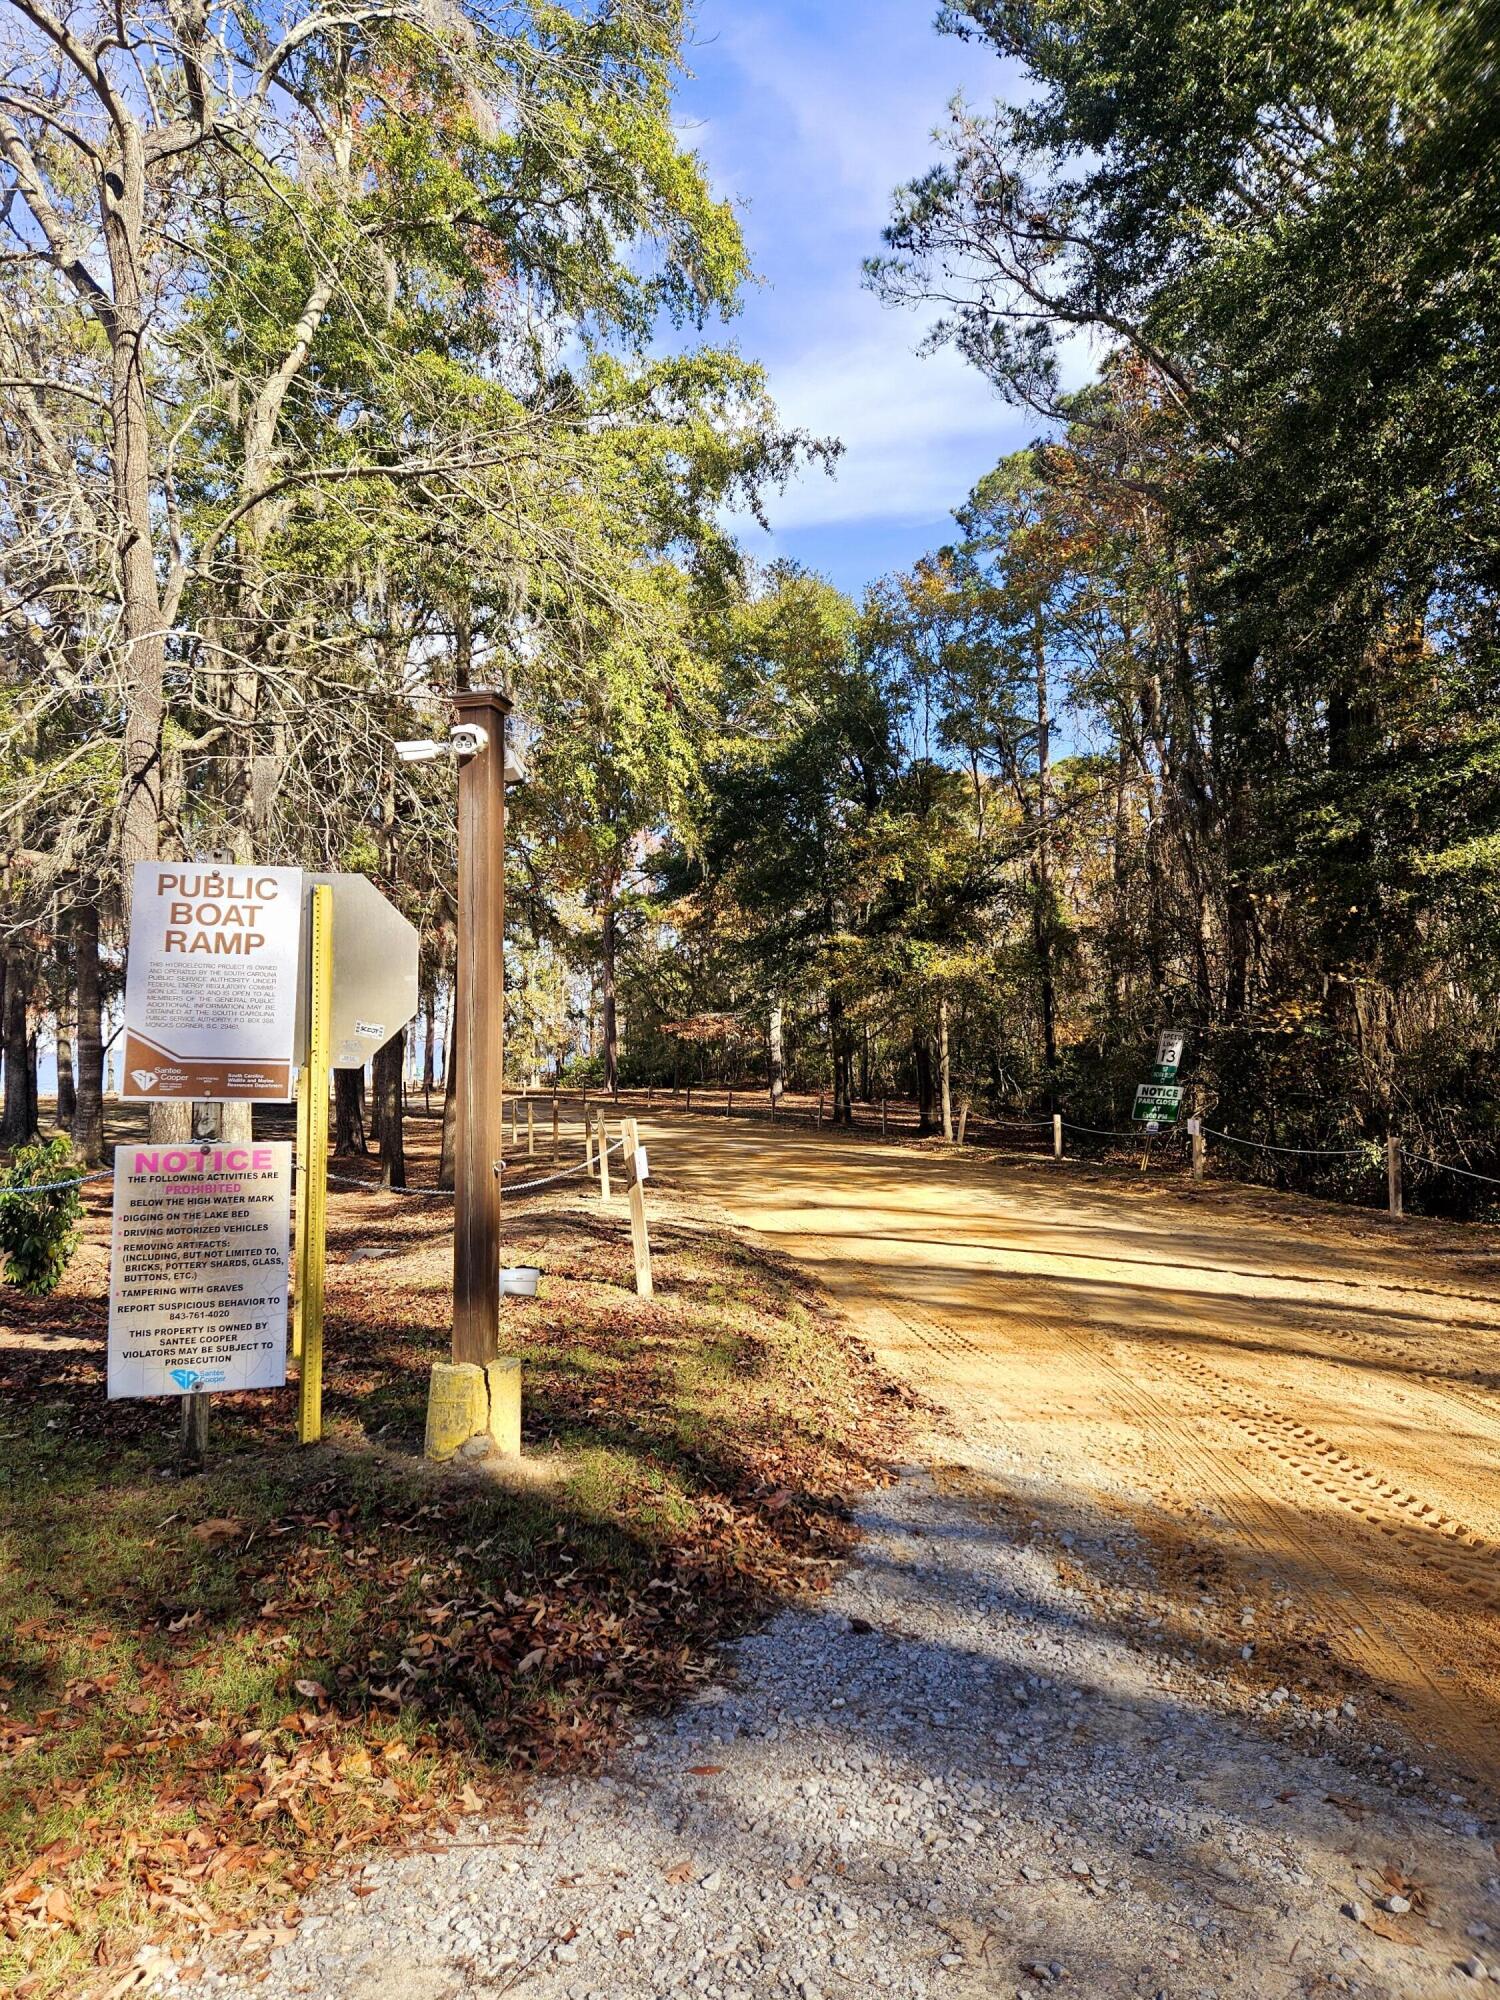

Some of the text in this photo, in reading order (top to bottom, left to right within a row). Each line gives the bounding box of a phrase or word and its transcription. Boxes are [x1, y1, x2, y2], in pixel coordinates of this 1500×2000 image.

[157, 873, 278, 901] PUBLIC
[169, 902, 263, 927] BOAT
[164, 929, 265, 955] RAMP
[1161, 1049, 1176, 1063] 13
[1141, 1087, 1179, 1098] NOTICE
[1155, 1098, 1179, 1106] CLOSES
[135, 1150, 273, 1174] NOTICE
[149, 1174, 204, 1183] FOLLOWING
[207, 1173, 258, 1181] ACTIVITIES
[165, 1183, 241, 1195] PROHIBITED
[130, 1199, 163, 1207] BELOW
[166, 1198, 184, 1206] THE
[213, 1196, 245, 1204] WATER
[248, 1195, 274, 1203] MARK
[123, 1213, 163, 1222] DIGGING
[183, 1212, 201, 1220] THE
[204, 1211, 229, 1219] LAKE
[231, 1210, 250, 1218] BED
[124, 1224, 269, 1237] DRIVING MOTORIZED VEHICLES
[123, 1240, 230, 1252] REMOVING ARTIFACTS:
[123, 1248, 279, 1263] (INCLUDING, BUT NOT LIMITED TO,
[125, 1257, 284, 1272] BRICKS, POTTERY SHARDS, GLASS,
[124, 1272, 197, 1282] BUTTONS, ETC.)
[122, 1284, 244, 1297] TAMPERING WITH GRAVES
[117, 1304, 155, 1313] REPORT
[158, 1301, 215, 1311] SUSPICIOUS
[218, 1298, 265, 1308] BEHAVIOR
[169, 1310, 230, 1320] 843-761-4020
[129, 1322, 268, 1338] THIS PROPERTY IS OWNED BY
[159, 1334, 238, 1346] SANTEE COOPER
[122, 1341, 274, 1359] VIOLATORS MAY BE SUBJECT TO
[165, 1355, 232, 1366] PROSECUTION
